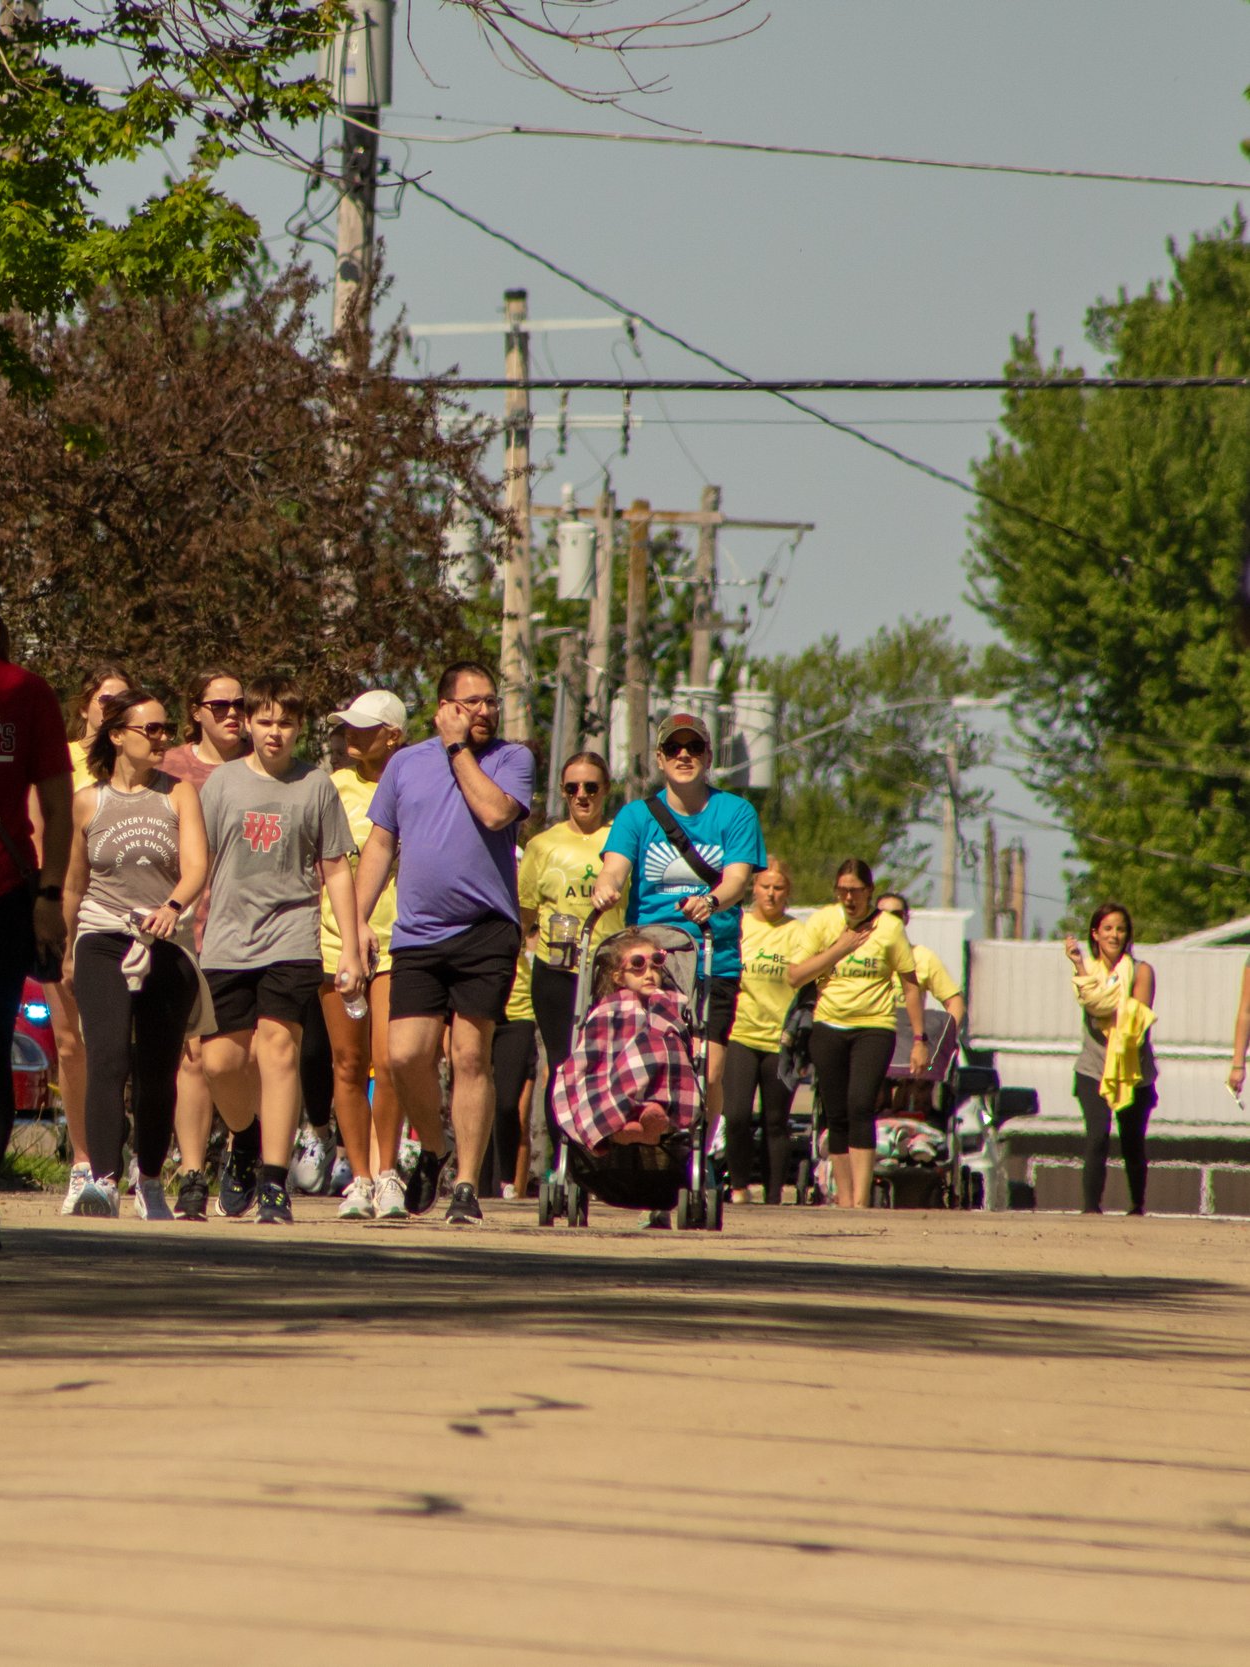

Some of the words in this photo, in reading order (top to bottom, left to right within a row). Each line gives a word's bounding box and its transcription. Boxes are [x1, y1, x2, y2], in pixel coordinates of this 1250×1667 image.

[94, 826, 116, 861] THROUGH
[116, 816, 144, 829] EVERY
[112, 827, 155, 845] THROUGH
[157, 832, 178, 852] EVERY
[116, 850, 125, 868] YOU
[125, 840, 141, 851] ARE
[144, 840, 170, 867] ENOUGH
[565, 885, 576, 898] A
[773, 954, 785, 964] BE
[865, 958, 877, 969] BE
[752, 963, 785, 976] LIGHT
[842, 969, 878, 978] LIGHT
